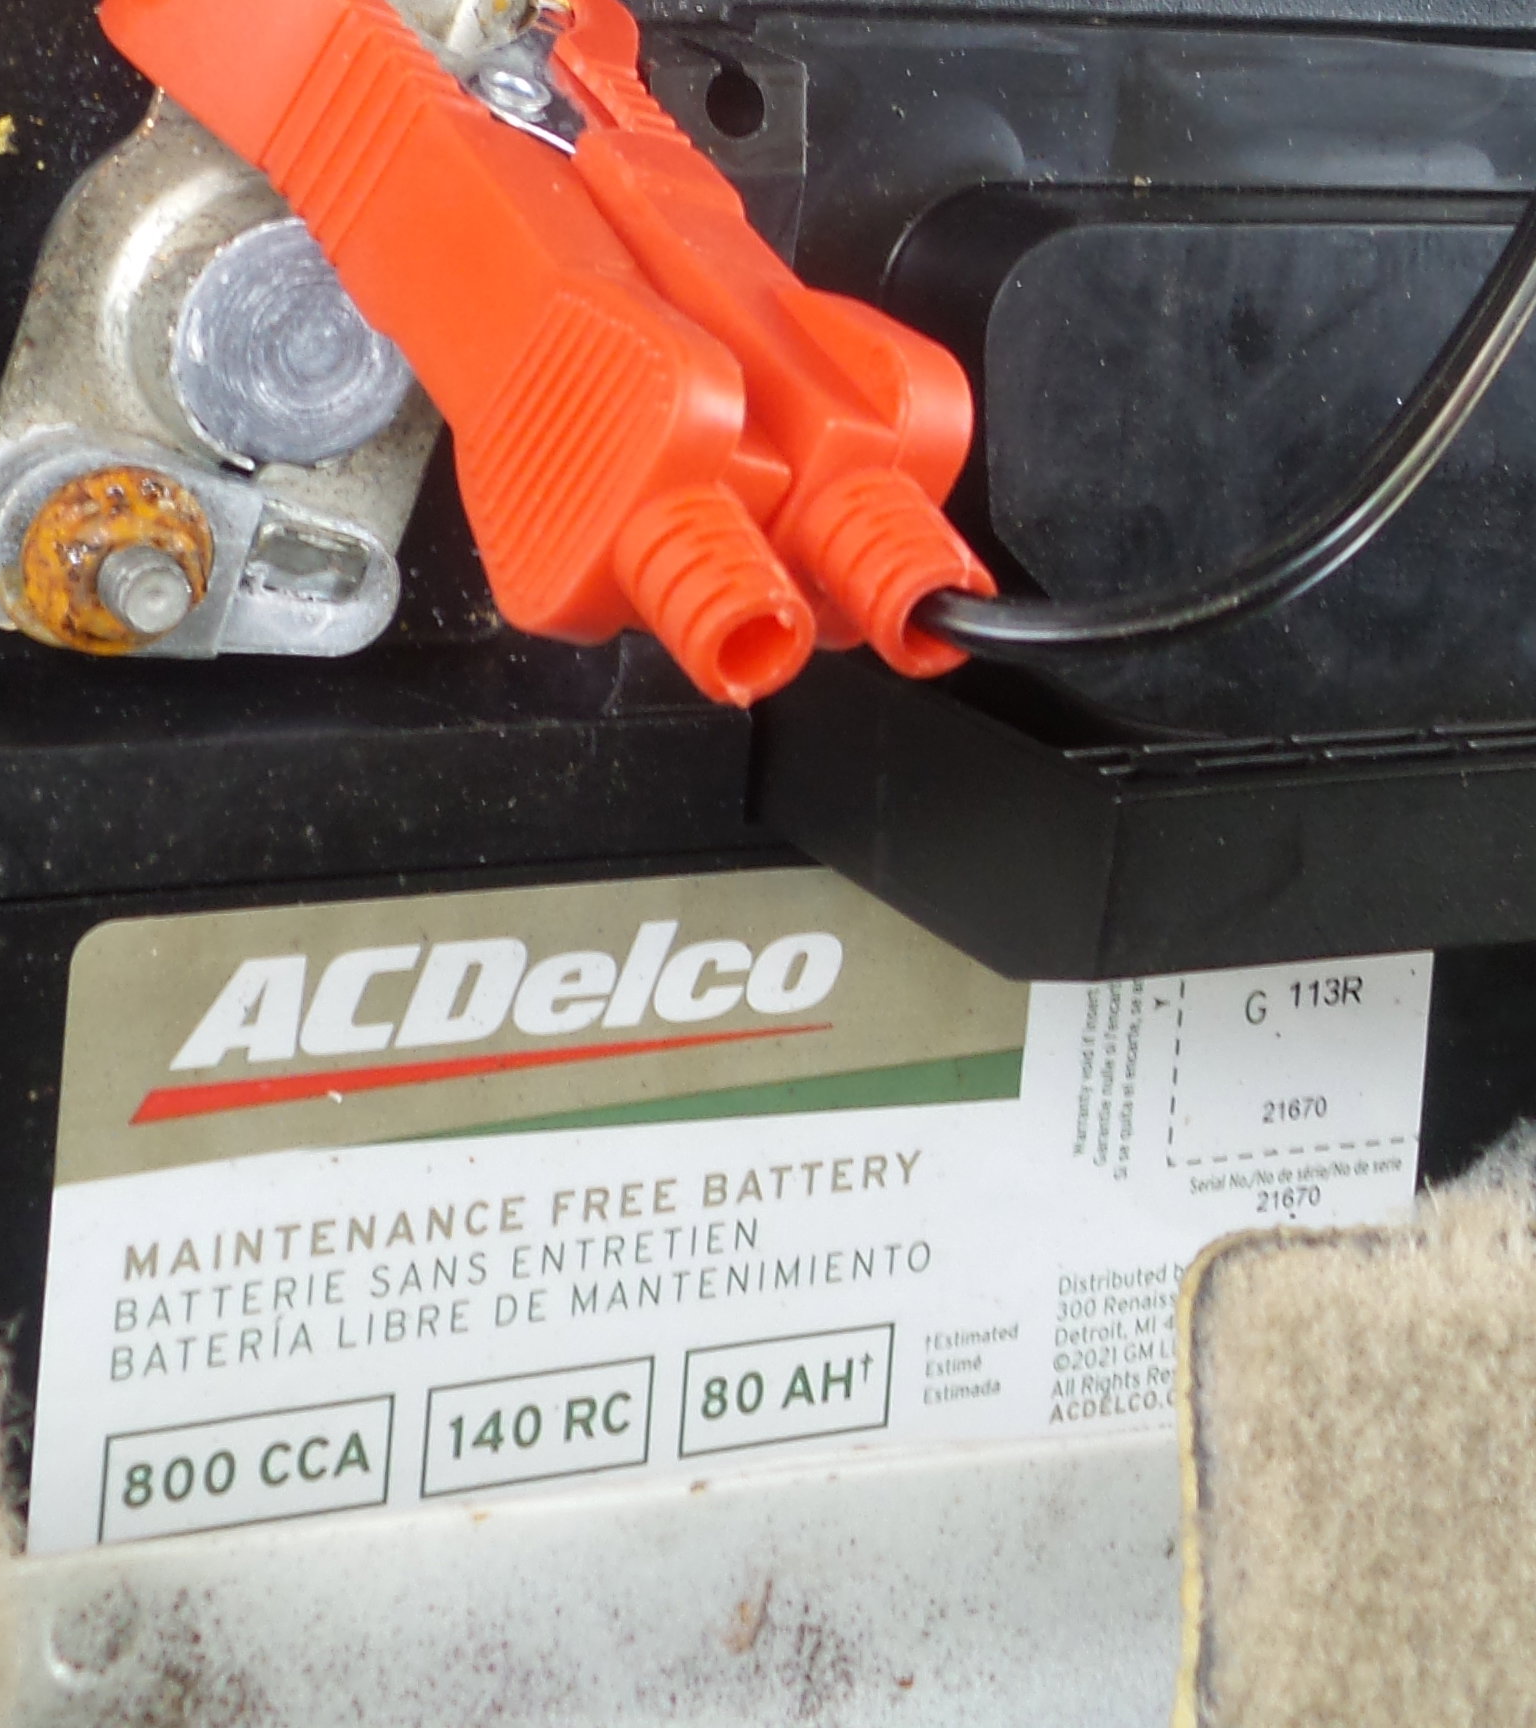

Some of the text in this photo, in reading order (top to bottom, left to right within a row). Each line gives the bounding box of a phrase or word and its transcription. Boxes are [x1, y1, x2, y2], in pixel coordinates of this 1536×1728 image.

[170, 920, 844, 1072] ACDelco
[1245, 976, 1362, 1024] G 113R
[1263, 1096, 1326, 1122] 21670
[124, 1150, 920, 1280] MAINTENANCE FREE BATTERY
[1256, 1185, 1320, 1211] 21670
[114, 1217, 756, 1331] BATTERIE SANS ENTRETIEN
[1058, 1263, 1166, 1295] Distributed
[110, 1240, 930, 1381] BATERÍA LIBRE DE MANTENIMIENTO
[1055, 1317, 1155, 1346] Detroit, MI
[1057, 1299, 1095, 1321] 300
[701, 1371, 763, 1420] 80
[1051, 1371, 1139, 1398] All Rights
[449, 1393, 630, 1458] 140 RC
[122, 1432, 369, 1508] 800 CCA
